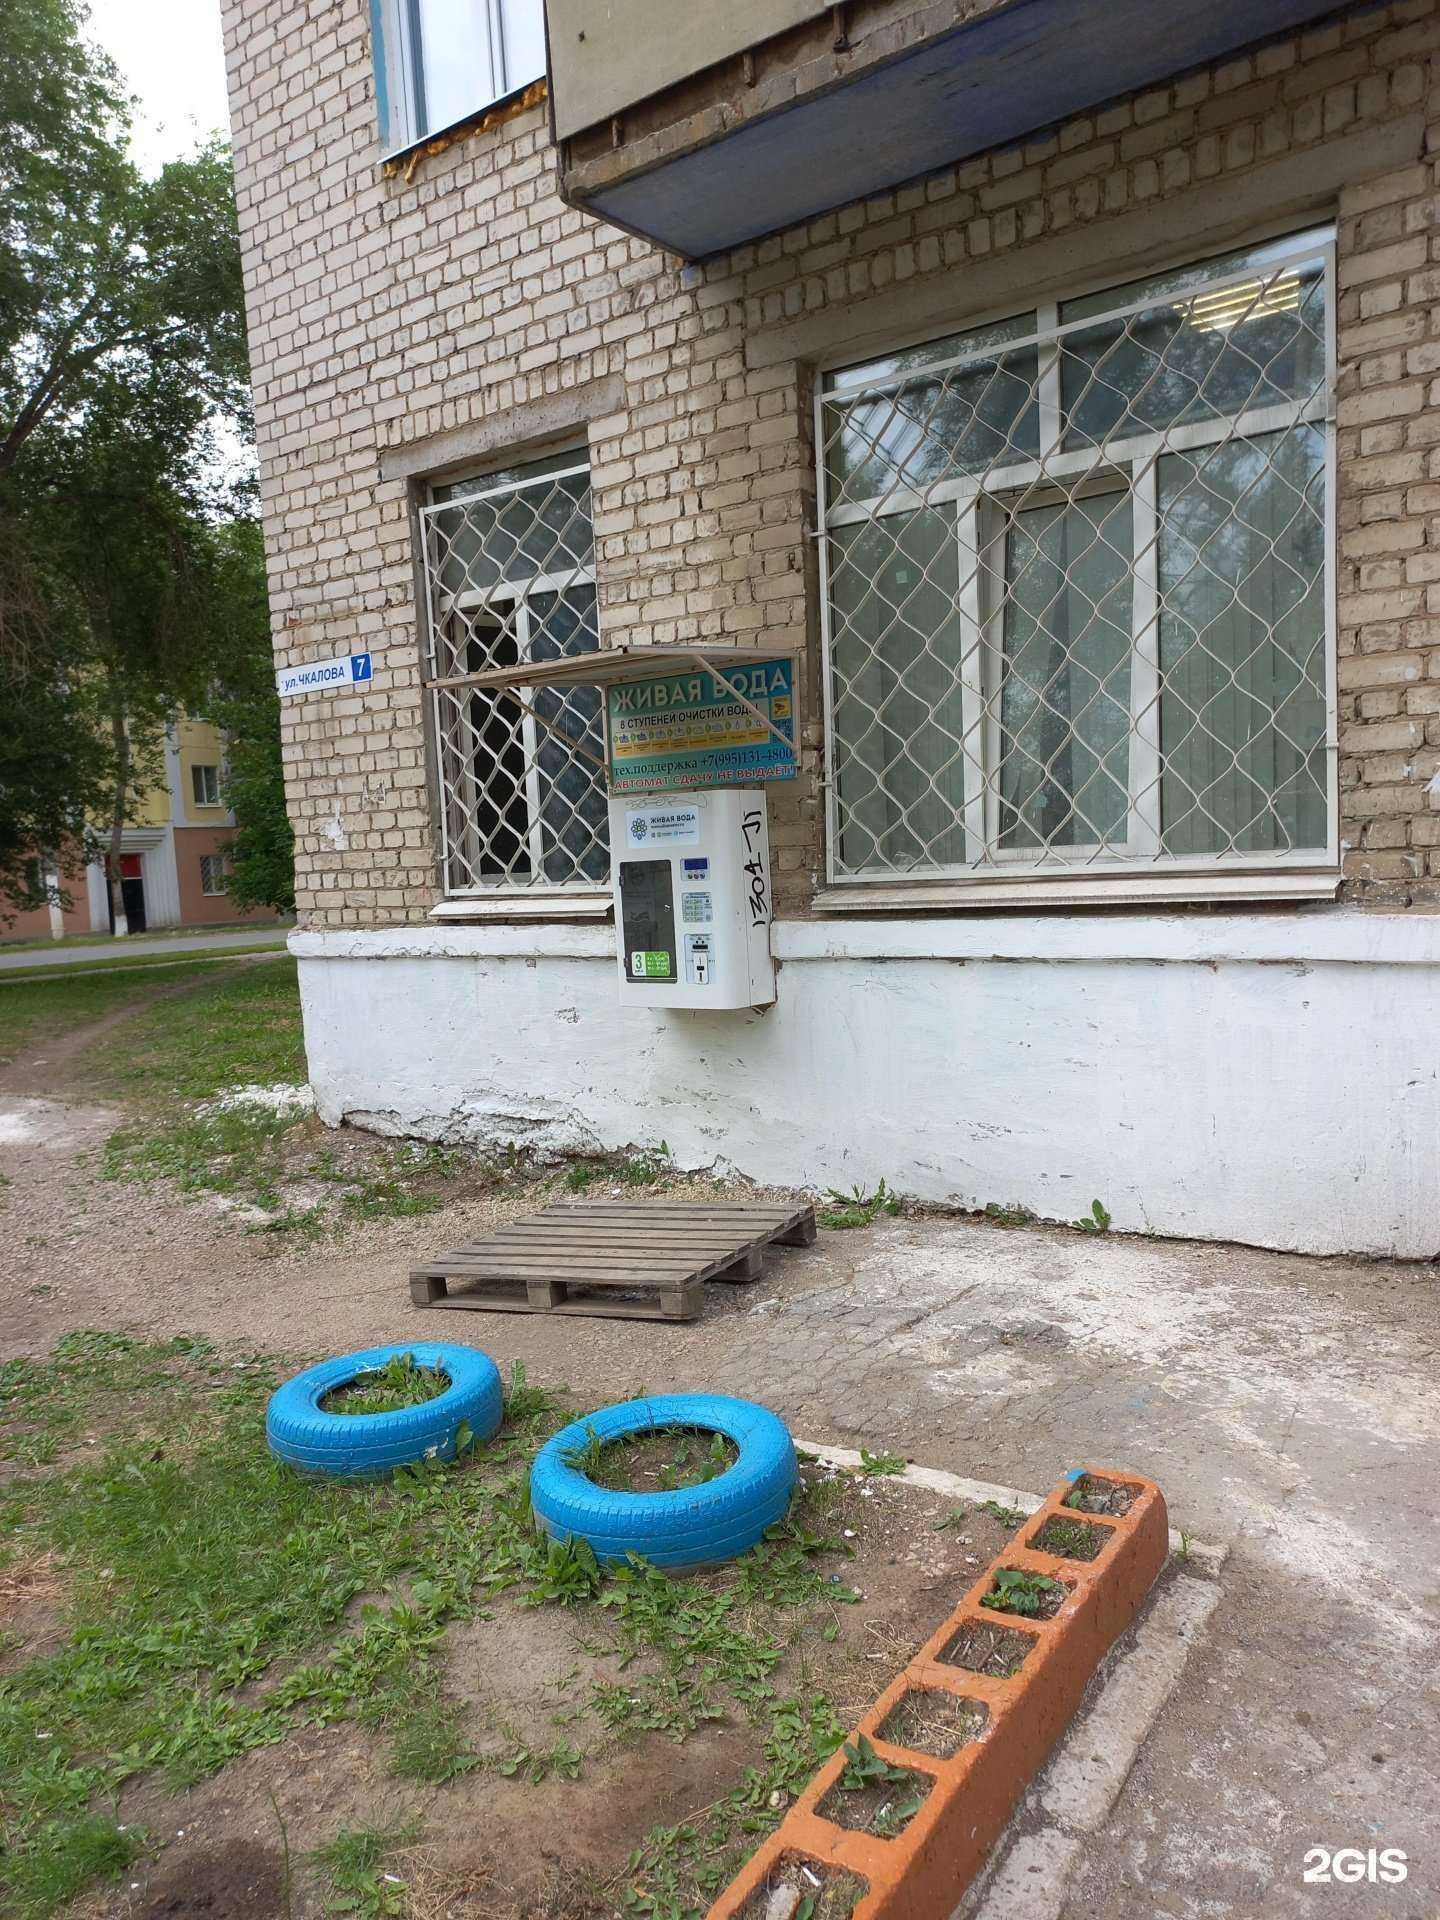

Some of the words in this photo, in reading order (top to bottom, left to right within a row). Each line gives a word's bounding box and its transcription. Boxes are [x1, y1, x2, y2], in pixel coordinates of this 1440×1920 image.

[357, 658, 365, 676] 7
[284, 666, 345, 691] ул.ЧКАЛОВА
[614, 680, 700, 712] ЖИВАЯ
[713, 667, 788, 698] ВОДА
[628, 712, 676, 728] СТУПЕНЕЙ
[679, 706, 724, 722] ОЧИСТКИ
[614, 760, 697, 776] тех.поддержка
[615, 776, 670, 789] АВТОМАТ
[673, 771, 712, 785] СДАЧУ
[717, 769, 733, 780] НЕ
[650, 816, 675, 824] ЖИВАЯ
[676, 814, 696, 822] ВОДА
[635, 954, 642, 969] 3
